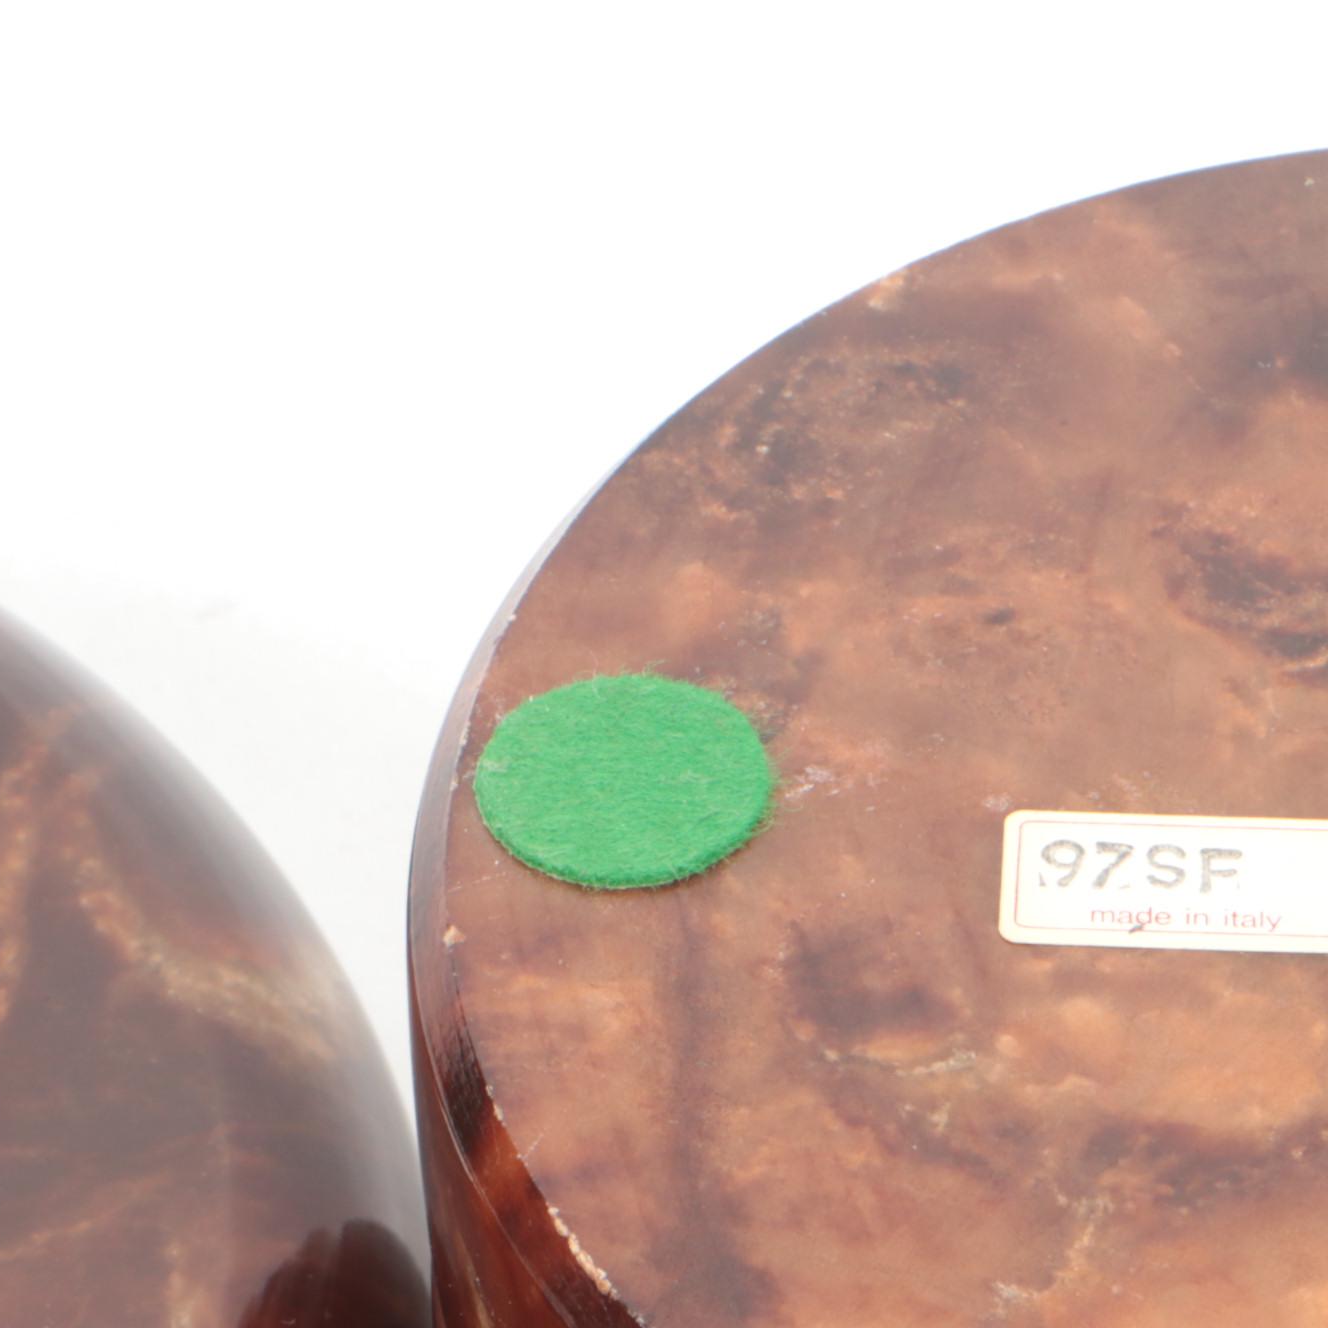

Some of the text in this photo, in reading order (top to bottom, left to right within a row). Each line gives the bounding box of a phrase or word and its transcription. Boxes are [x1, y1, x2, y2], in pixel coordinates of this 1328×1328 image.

[1089, 907, 1283, 933] made in italy
